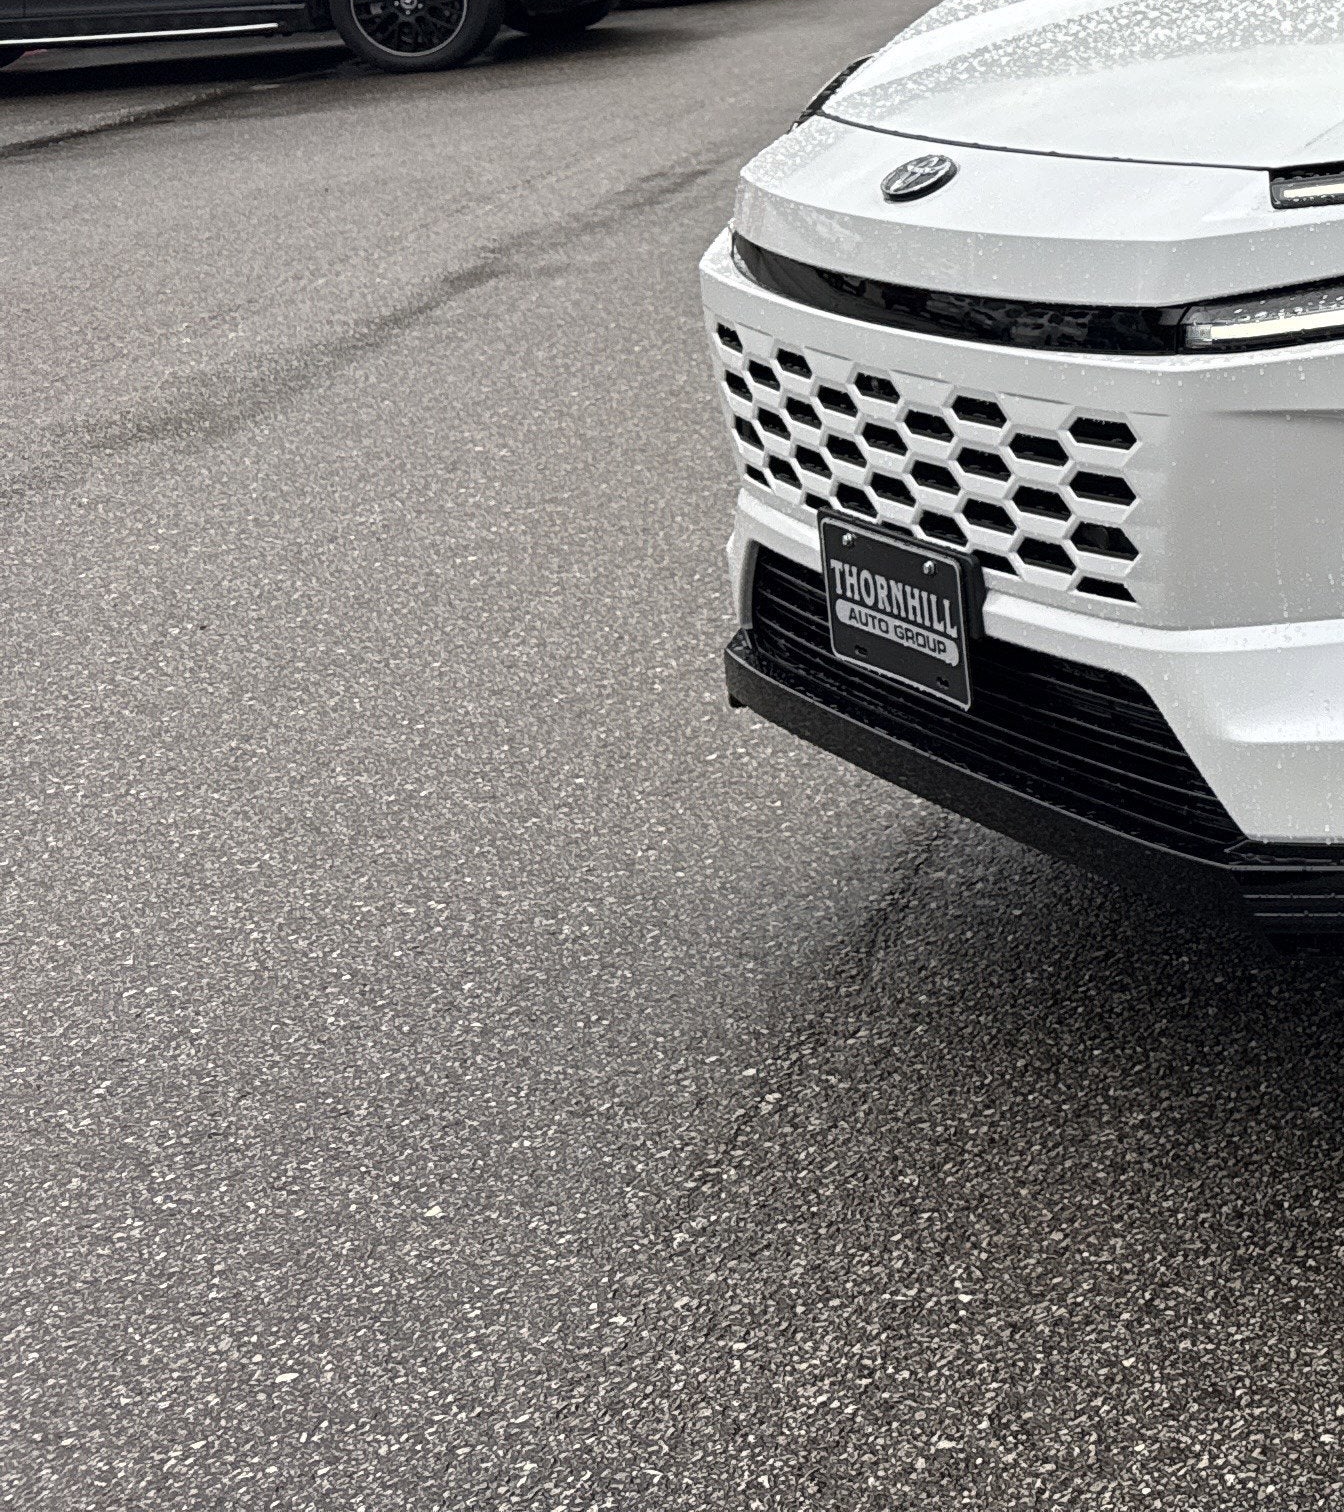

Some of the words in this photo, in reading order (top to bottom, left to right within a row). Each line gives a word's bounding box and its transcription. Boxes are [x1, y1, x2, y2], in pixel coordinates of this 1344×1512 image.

[830, 559, 958, 639] THORNHILL
[848, 607, 889, 635] AUTO
[894, 624, 947, 656] GROUP
